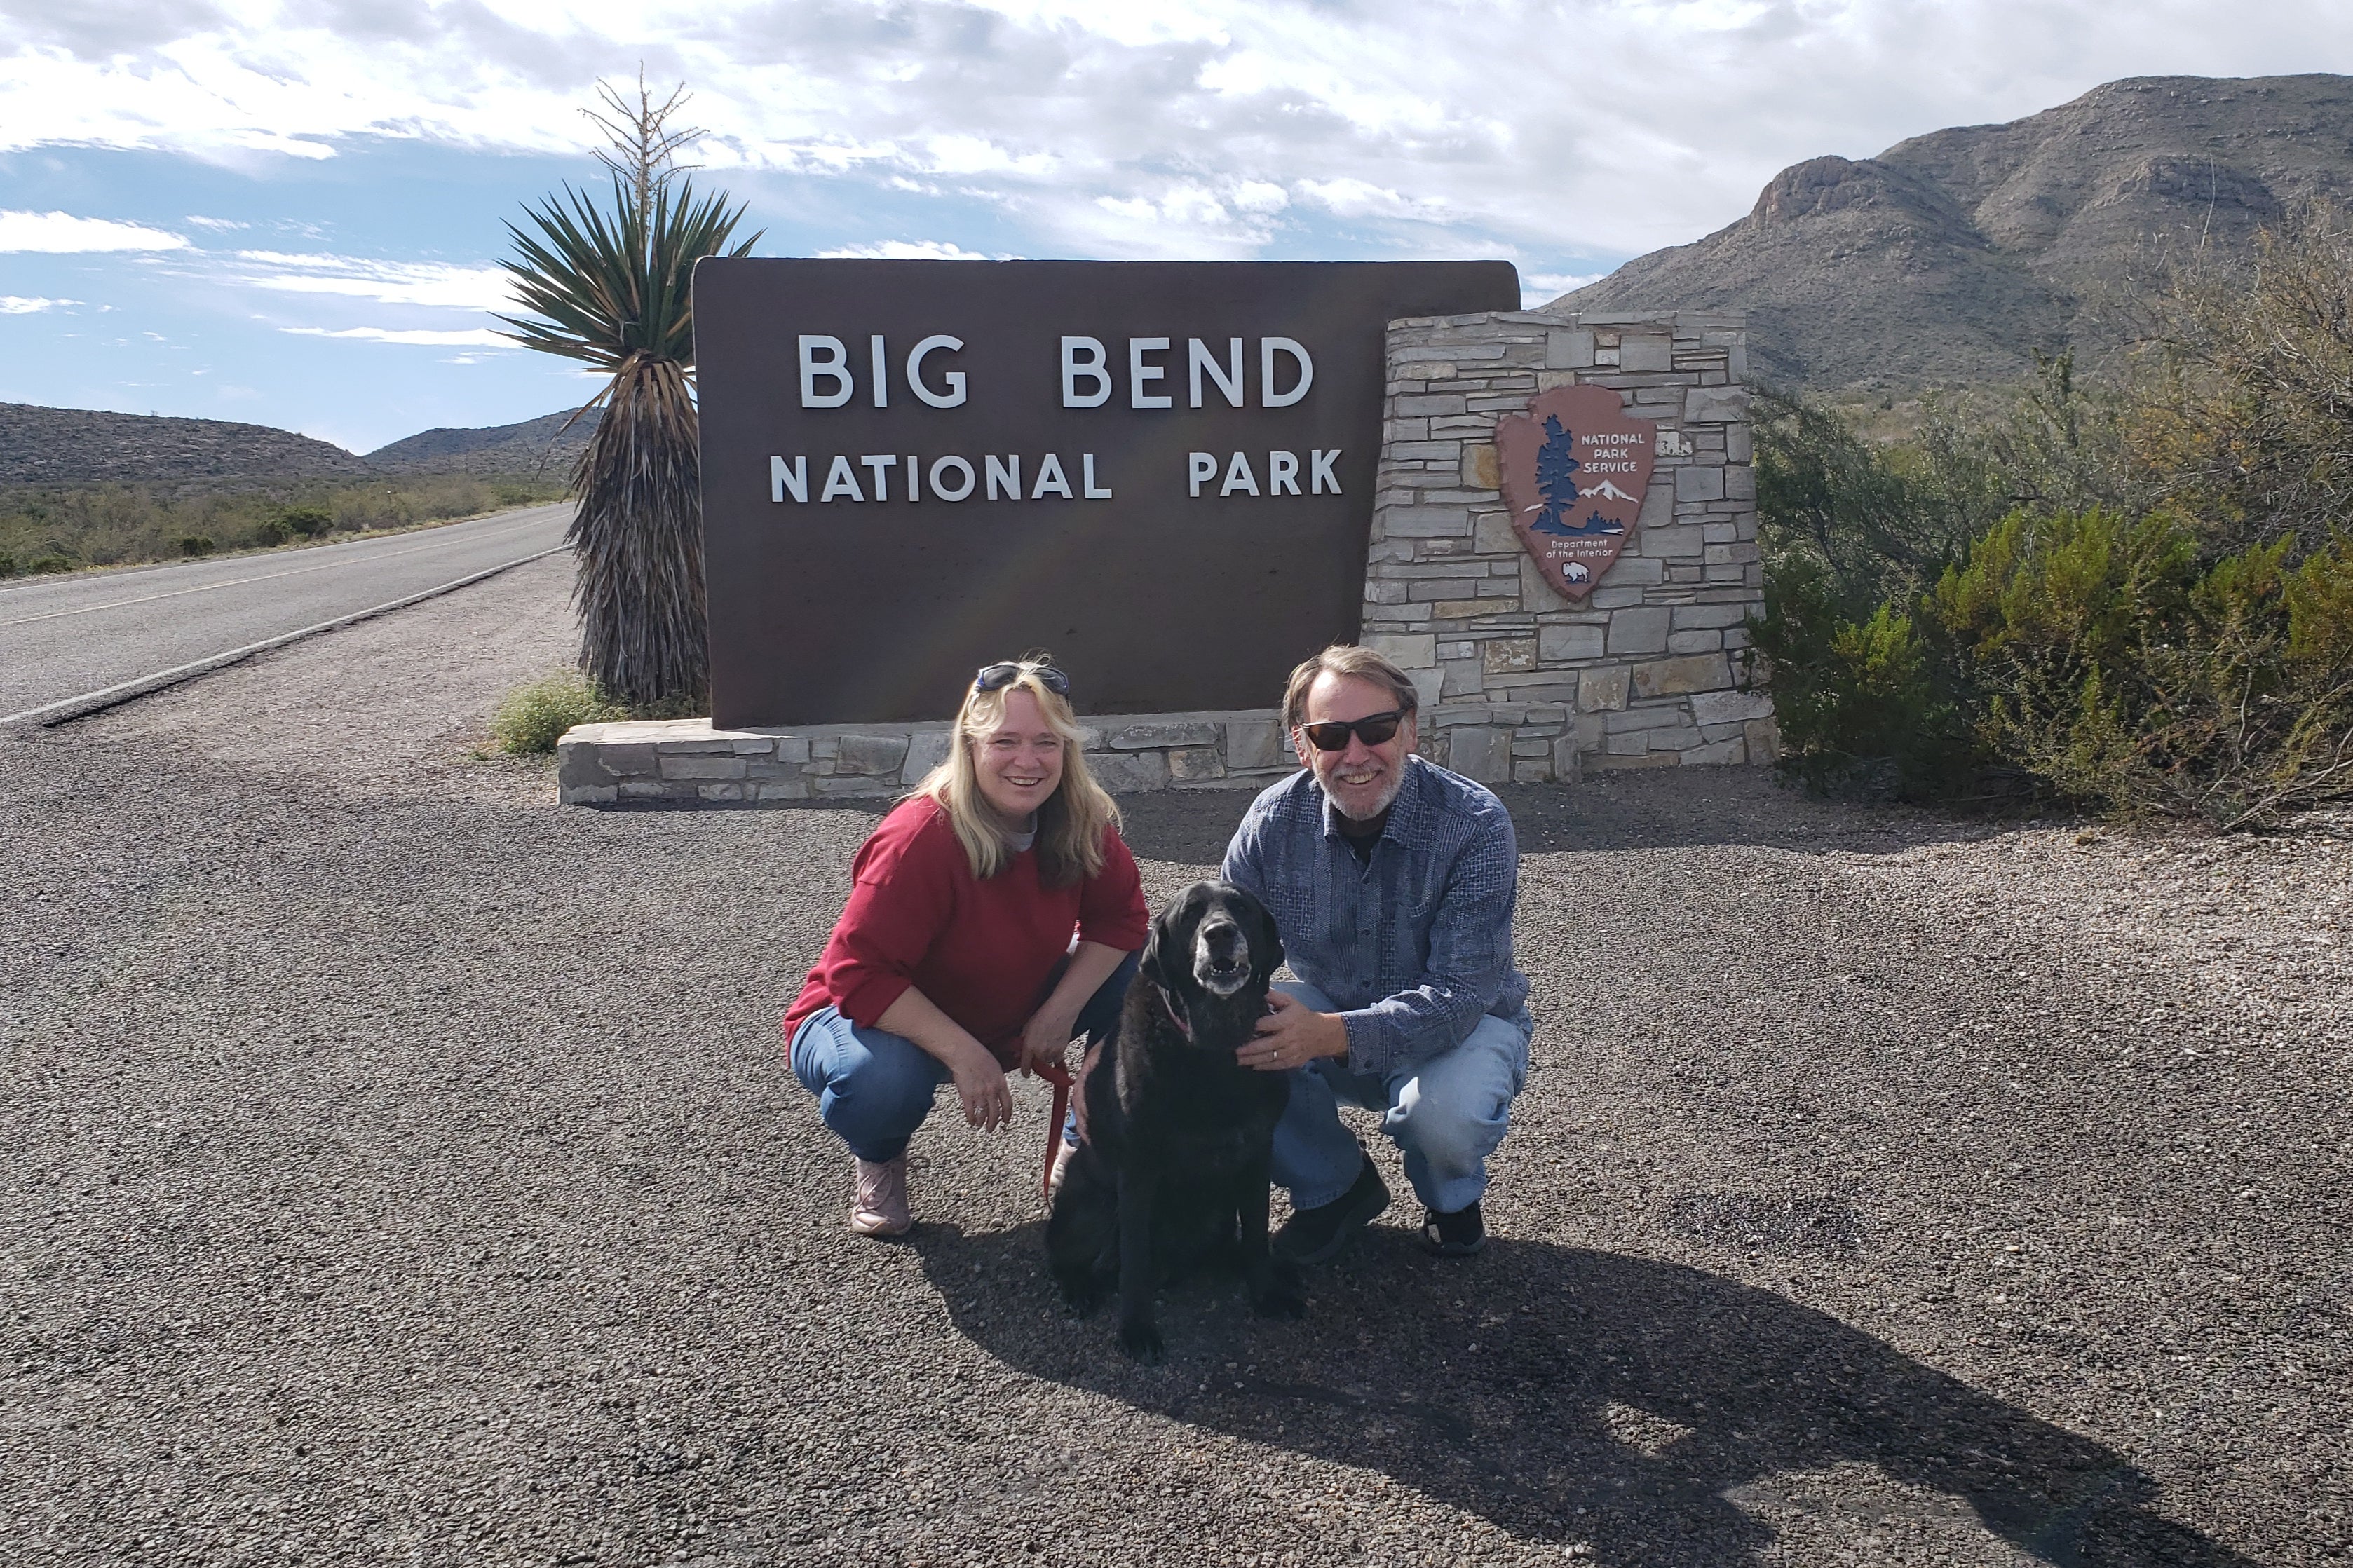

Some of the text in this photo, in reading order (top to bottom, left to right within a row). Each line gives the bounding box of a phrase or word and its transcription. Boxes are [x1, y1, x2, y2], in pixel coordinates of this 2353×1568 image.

[798, 334, 1314, 409] BIG BEND
[1582, 433, 1645, 445] NATIONAL
[1594, 449, 1628, 459] PARK
[1583, 461, 1637, 473] SERVICE
[770, 449, 1343, 503] NATIONAL PARK
[1552, 539, 1608, 550] Department
[1546, 548, 1613, 558] of the Interior
